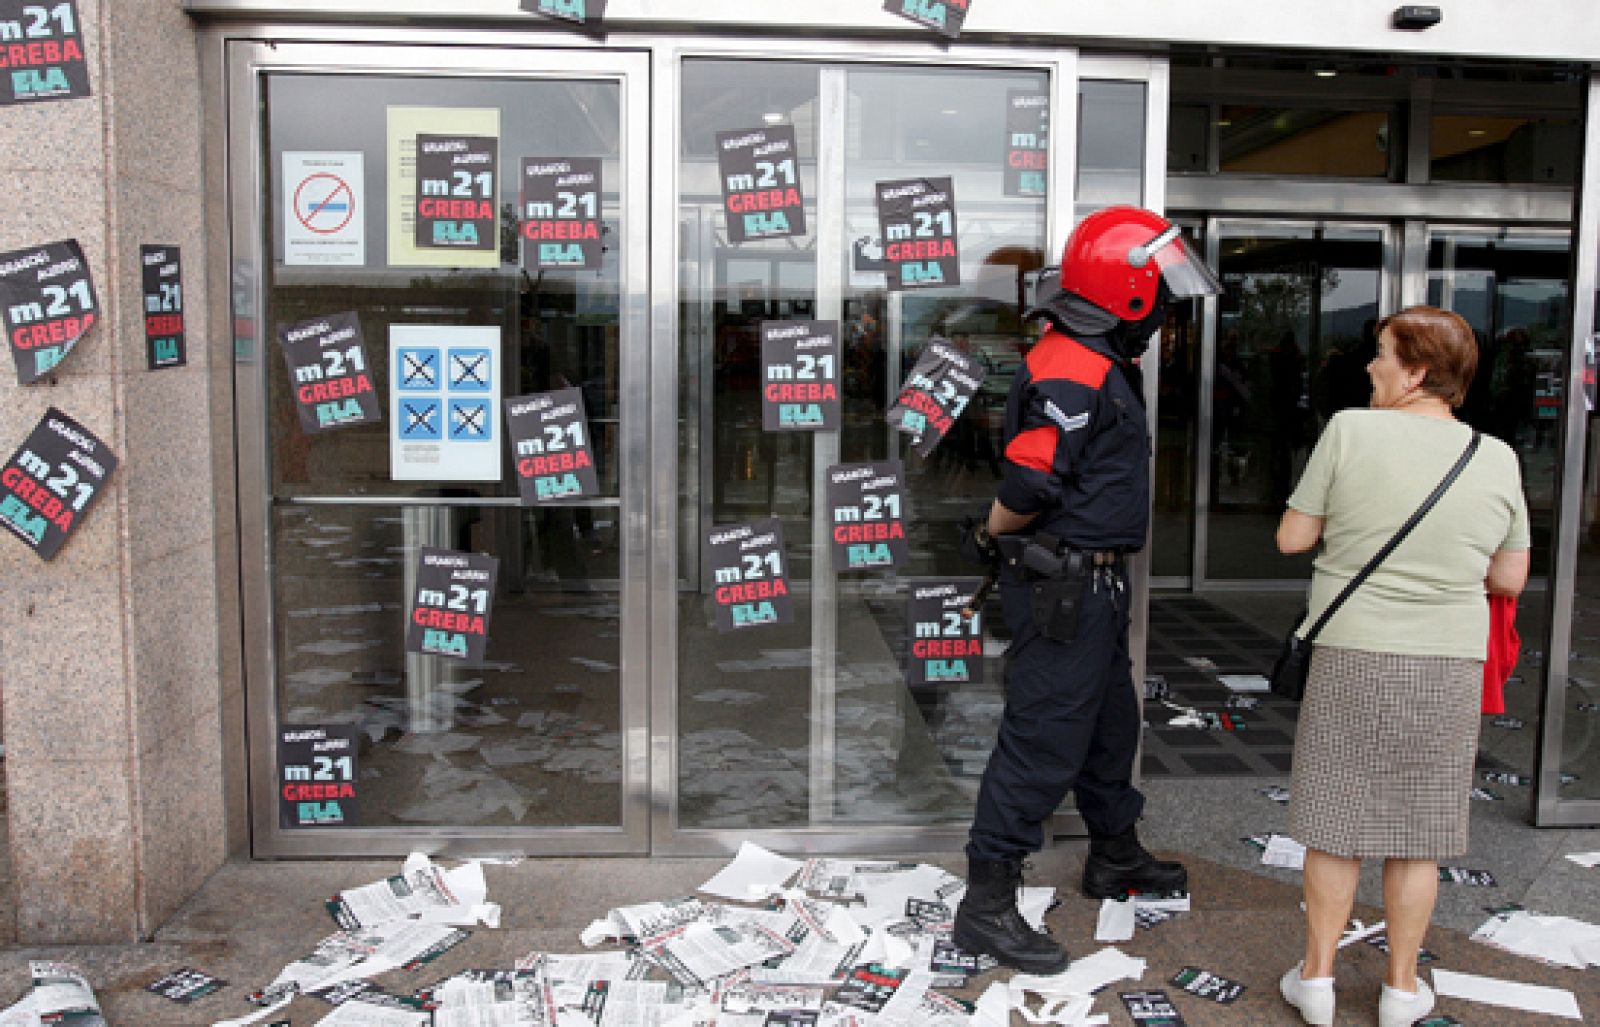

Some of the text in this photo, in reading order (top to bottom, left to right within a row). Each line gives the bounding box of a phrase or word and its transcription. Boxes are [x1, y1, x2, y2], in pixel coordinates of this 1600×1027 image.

[12, 67, 70, 93] ELA
[422, 169, 492, 198] m21
[727, 159, 795, 190] m21
[419, 198, 494, 220] GREBA
[527, 192, 597, 218] m21
[727, 188, 800, 213] GREBA
[433, 221, 478, 242] ELA
[526, 220, 599, 239] GREBA
[744, 211, 790, 233] ELA
[886, 209, 952, 240] m21
[538, 243, 585, 263] ELA
[886, 238, 956, 262] GREBA
[901, 261, 944, 281] ELA
[8, 279, 94, 324] m21
[295, 345, 365, 382] m21
[764, 354, 835, 381] m21
[297, 374, 373, 404] GREBA
[764, 383, 836, 402] GREBA
[316, 398, 364, 423] ELA
[779, 404, 824, 423] ELA
[517, 421, 586, 455] m21
[518, 449, 592, 477] GREBA
[17, 449, 94, 511] m21
[535, 473, 582, 498] ELA
[2, 467, 74, 533] GREBA
[834, 494, 902, 521] m21
[833, 519, 905, 544] GREBA
[847, 543, 893, 564] ELA
[715, 550, 782, 584] m21
[418, 584, 489, 614] m21
[716, 578, 790, 605] GREBA
[413, 607, 485, 635] GREBA
[731, 602, 777, 624] ELA
[916, 611, 981, 638] m21
[423, 628, 467, 655] ELA
[913, 639, 983, 658] GREBA
[925, 659, 970, 679] ELA
[284, 756, 353, 781] m21
[282, 783, 356, 800] GREBA
[297, 800, 343, 820] ELA
